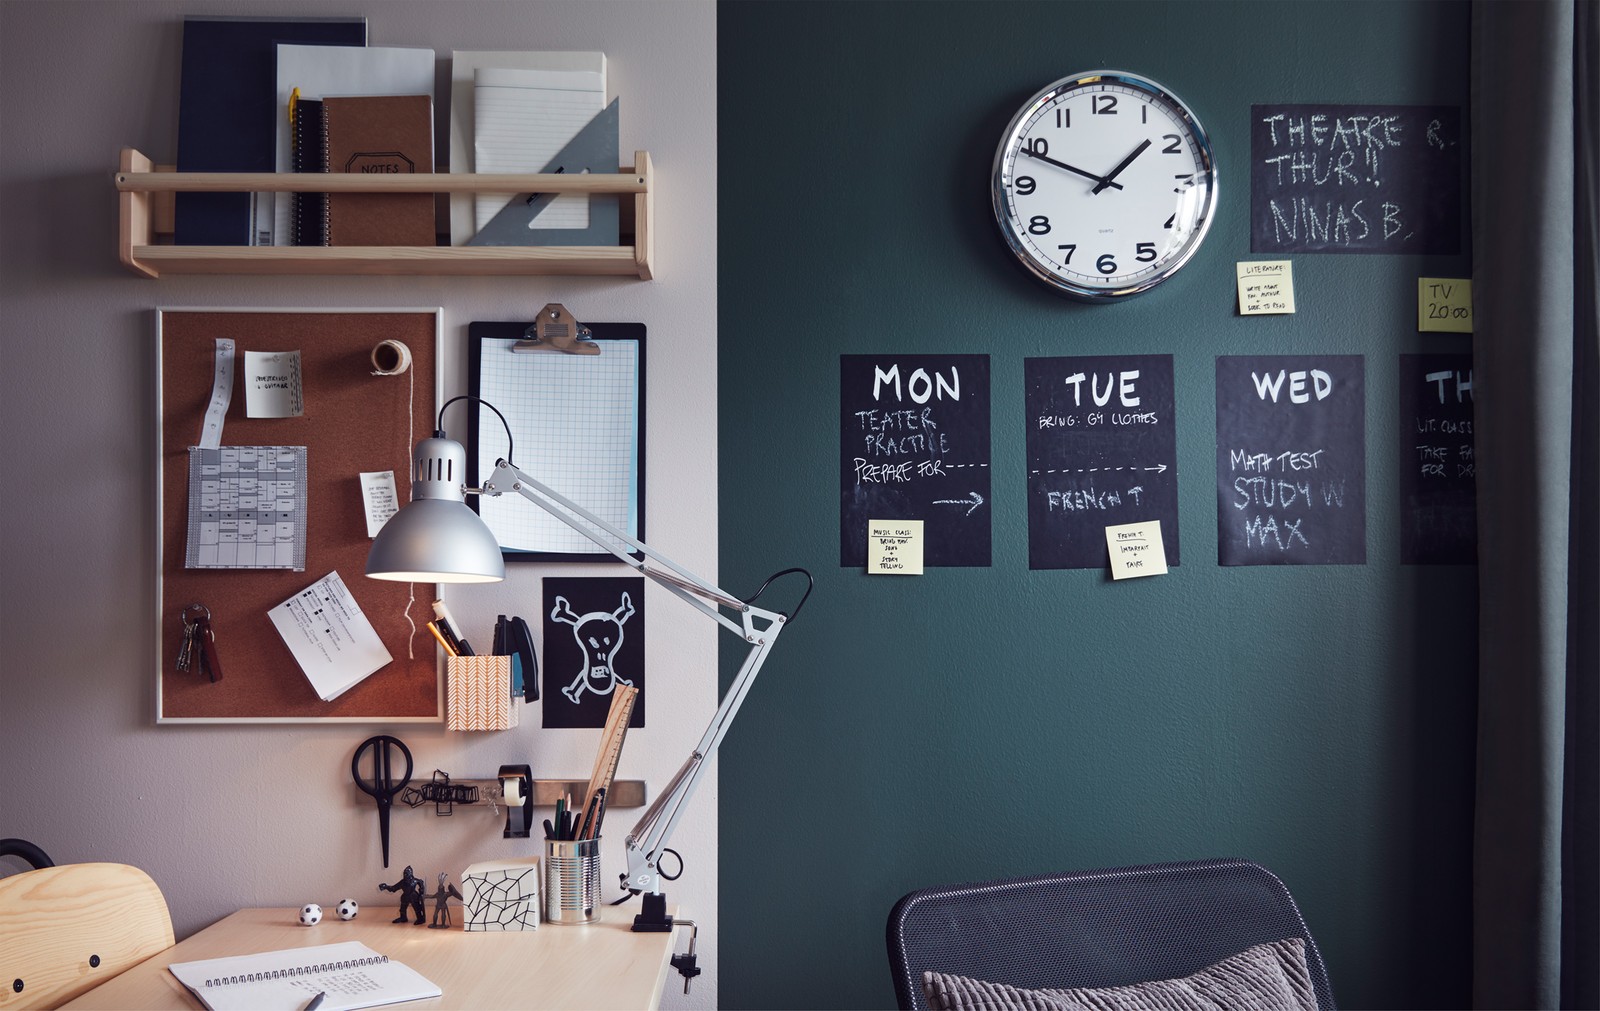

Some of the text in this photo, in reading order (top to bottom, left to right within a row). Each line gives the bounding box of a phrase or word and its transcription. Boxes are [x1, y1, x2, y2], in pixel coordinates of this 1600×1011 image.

[1092, 95, 1118, 115] 12
[1142, 104, 1147, 124] 1
[1056, 108, 1071, 128] 11
[1263, 113, 1403, 151] THEATRE
[1026, 137, 1049, 159] 10
[1162, 134, 1183, 155] 2
[361, 164, 399, 174] NOTES
[1014, 175, 1037, 196] 9
[1028, 215, 1052, 236] 8
[1270, 196, 1370, 248] NINAS
[1058, 244, 1077, 265] 7
[1134, 242, 1158, 263] 5
[1096, 254, 1118, 275] 6
[1429, 284, 1452, 299] TV
[873, 363, 961, 405] MON
[1065, 369, 1141, 408] TUE
[1251, 369, 1335, 405] WED
[855, 407, 937, 432] TEATER
[1038, 414, 1080, 430] BRING:
[1111, 411, 1159, 427] CLOTHES
[1230, 448, 1327, 473] MATH TEST
[1416, 445, 1449, 463] TAKE
[853, 457, 947, 485] PREPARE FOR
[1421, 463, 1448, 478] FOR
[1047, 485, 1145, 512] FRENCH T
[1233, 476, 1346, 511] STUDY W
[1245, 514, 1311, 552] MAX
